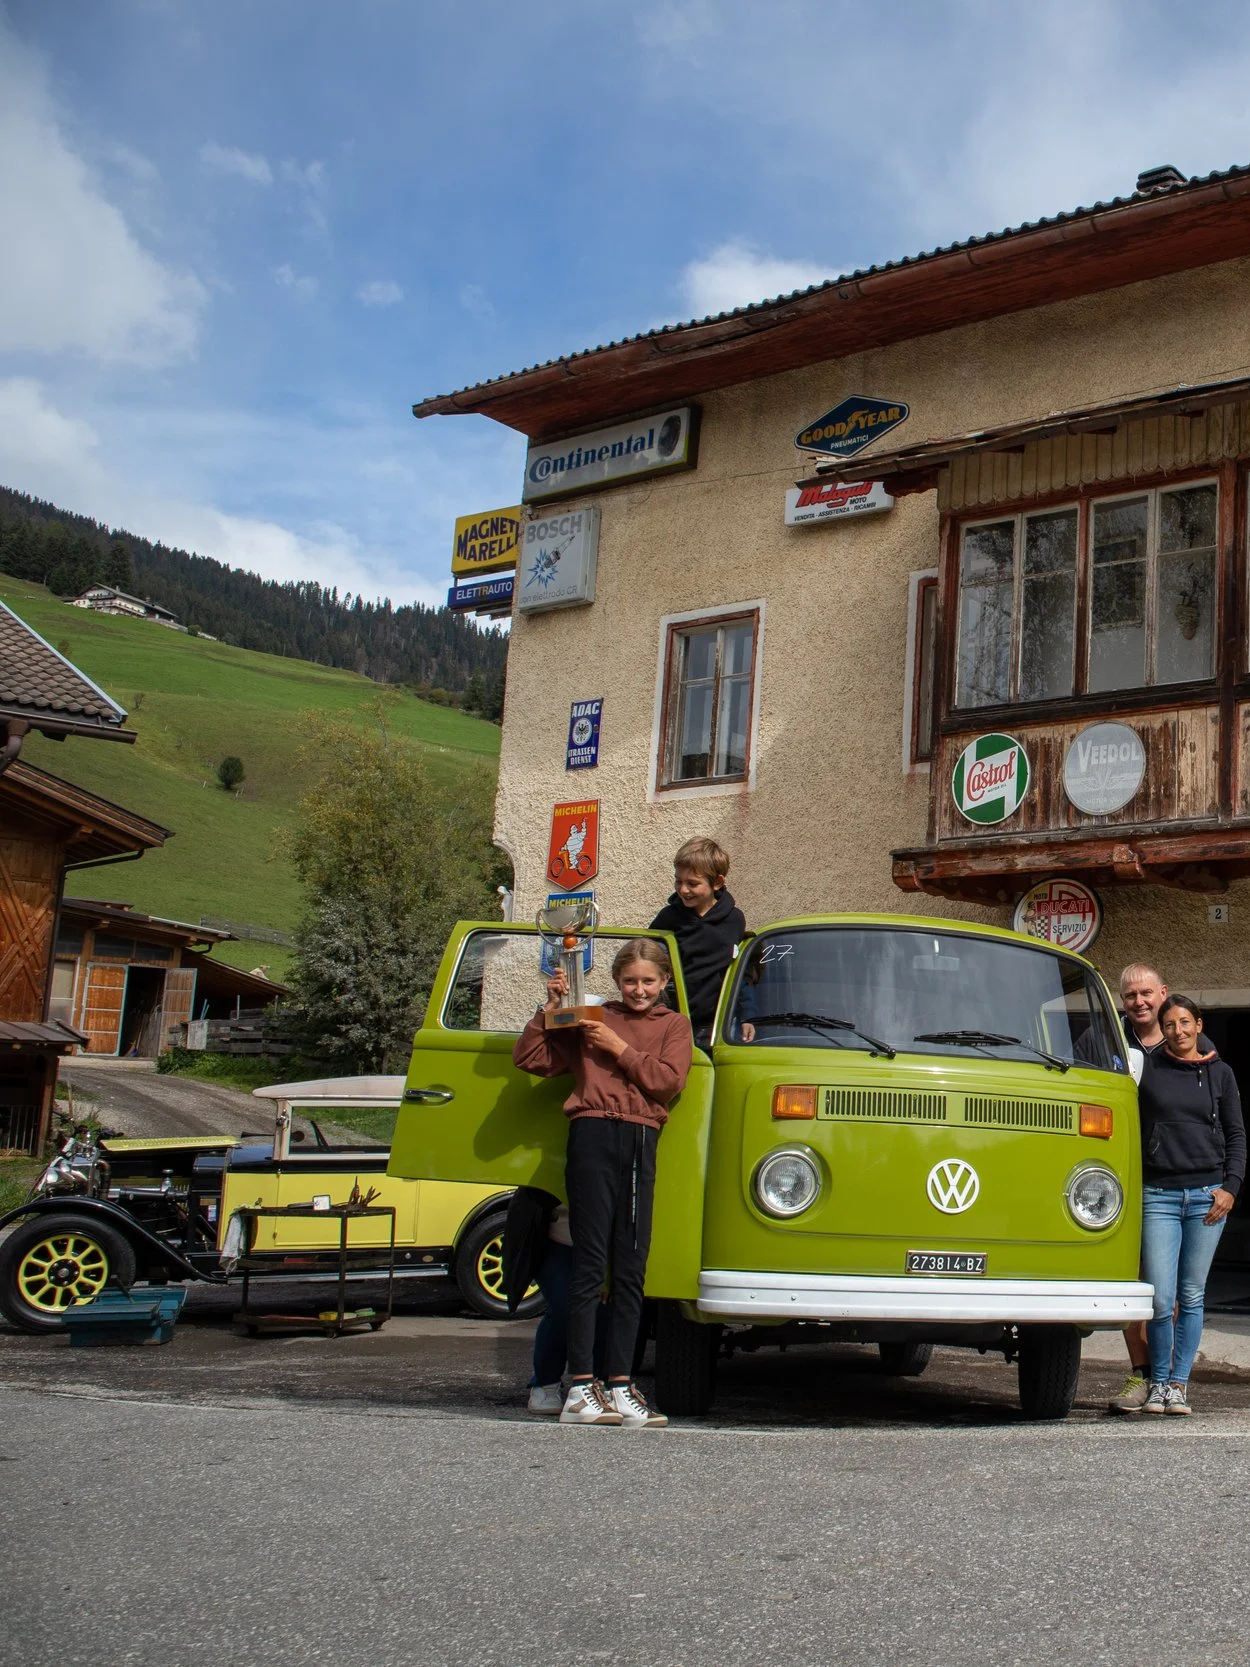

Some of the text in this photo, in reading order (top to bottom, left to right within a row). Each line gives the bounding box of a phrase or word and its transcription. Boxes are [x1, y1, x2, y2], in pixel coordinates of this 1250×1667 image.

[830, 434, 868, 450] PNEUMATICI
[529, 428, 654, 483] Continental
[849, 496, 867, 505] MOTO
[794, 502, 876, 521] VENDITA ASSISTENZA RICAMBI
[526, 514, 583, 544] BOSCH
[456, 581, 512, 600] ELETTRAUTO
[571, 702, 600, 718] ADAC
[568, 746, 596, 757] STRASSEN
[1077, 740, 1140, 772] VEEDOL
[570, 755, 592, 765] DIENST
[966, 751, 1018, 802] Castrol
[554, 804, 598, 817] MICHELIN
[1041, 900, 1090, 914] DUCATI
[1215, 907, 1222, 920] 2
[1052, 923, 1087, 934] SERVIZIO
[759, 944, 795, 964] 27
[926, 1158, 980, 1214] VW
[912, 1256, 983, 1271] 273814 BZ
